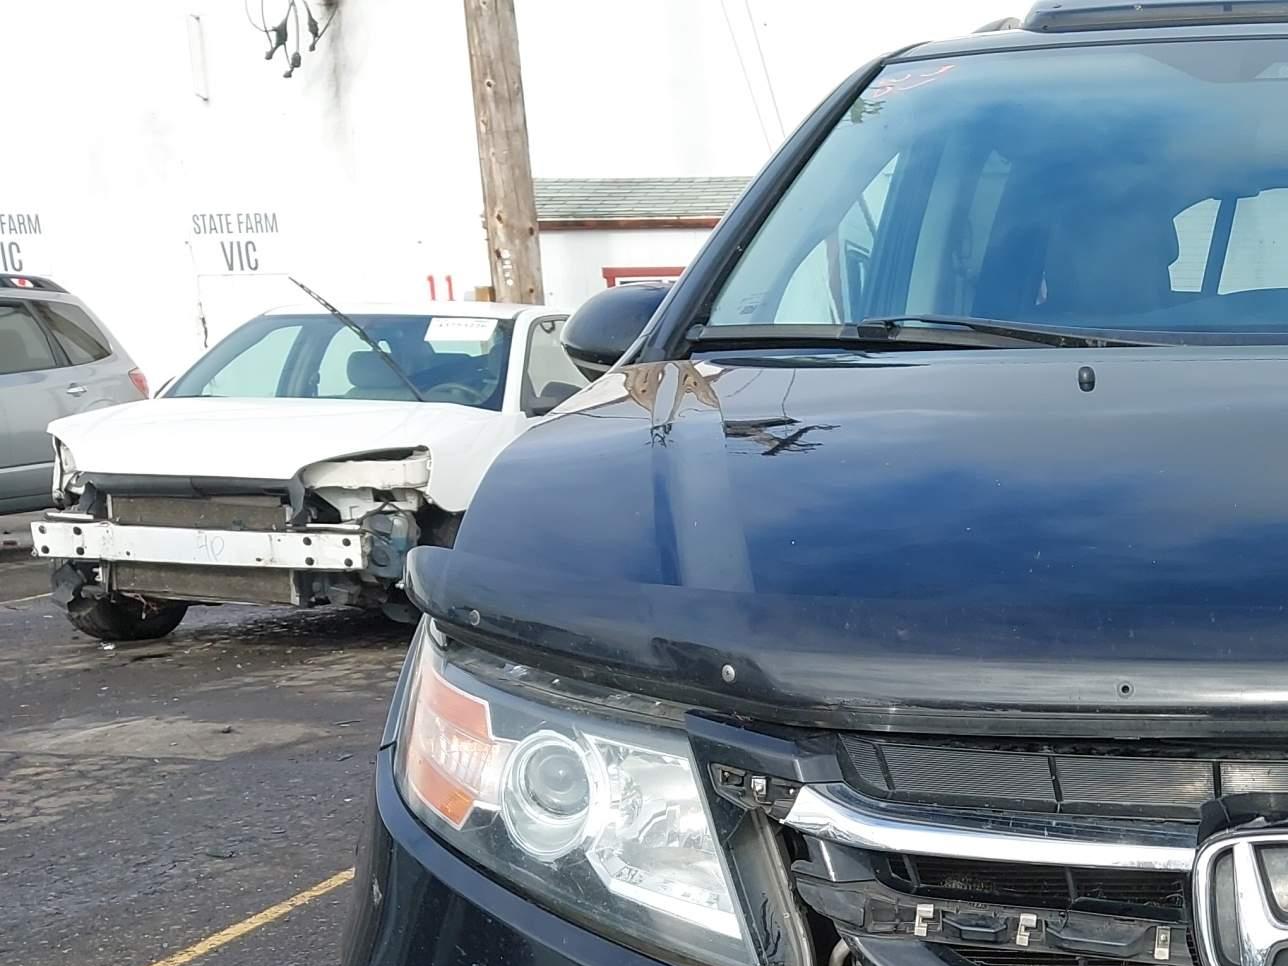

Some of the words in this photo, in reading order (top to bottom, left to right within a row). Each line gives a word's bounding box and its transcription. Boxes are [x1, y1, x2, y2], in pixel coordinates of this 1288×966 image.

[0, 213, 42, 235] FARM
[192, 213, 233, 235] STATE
[237, 212, 279, 234] FARM
[0, 241, 23, 272] IC
[220, 240, 259, 272] VIC
[426, 274, 456, 302] 11
